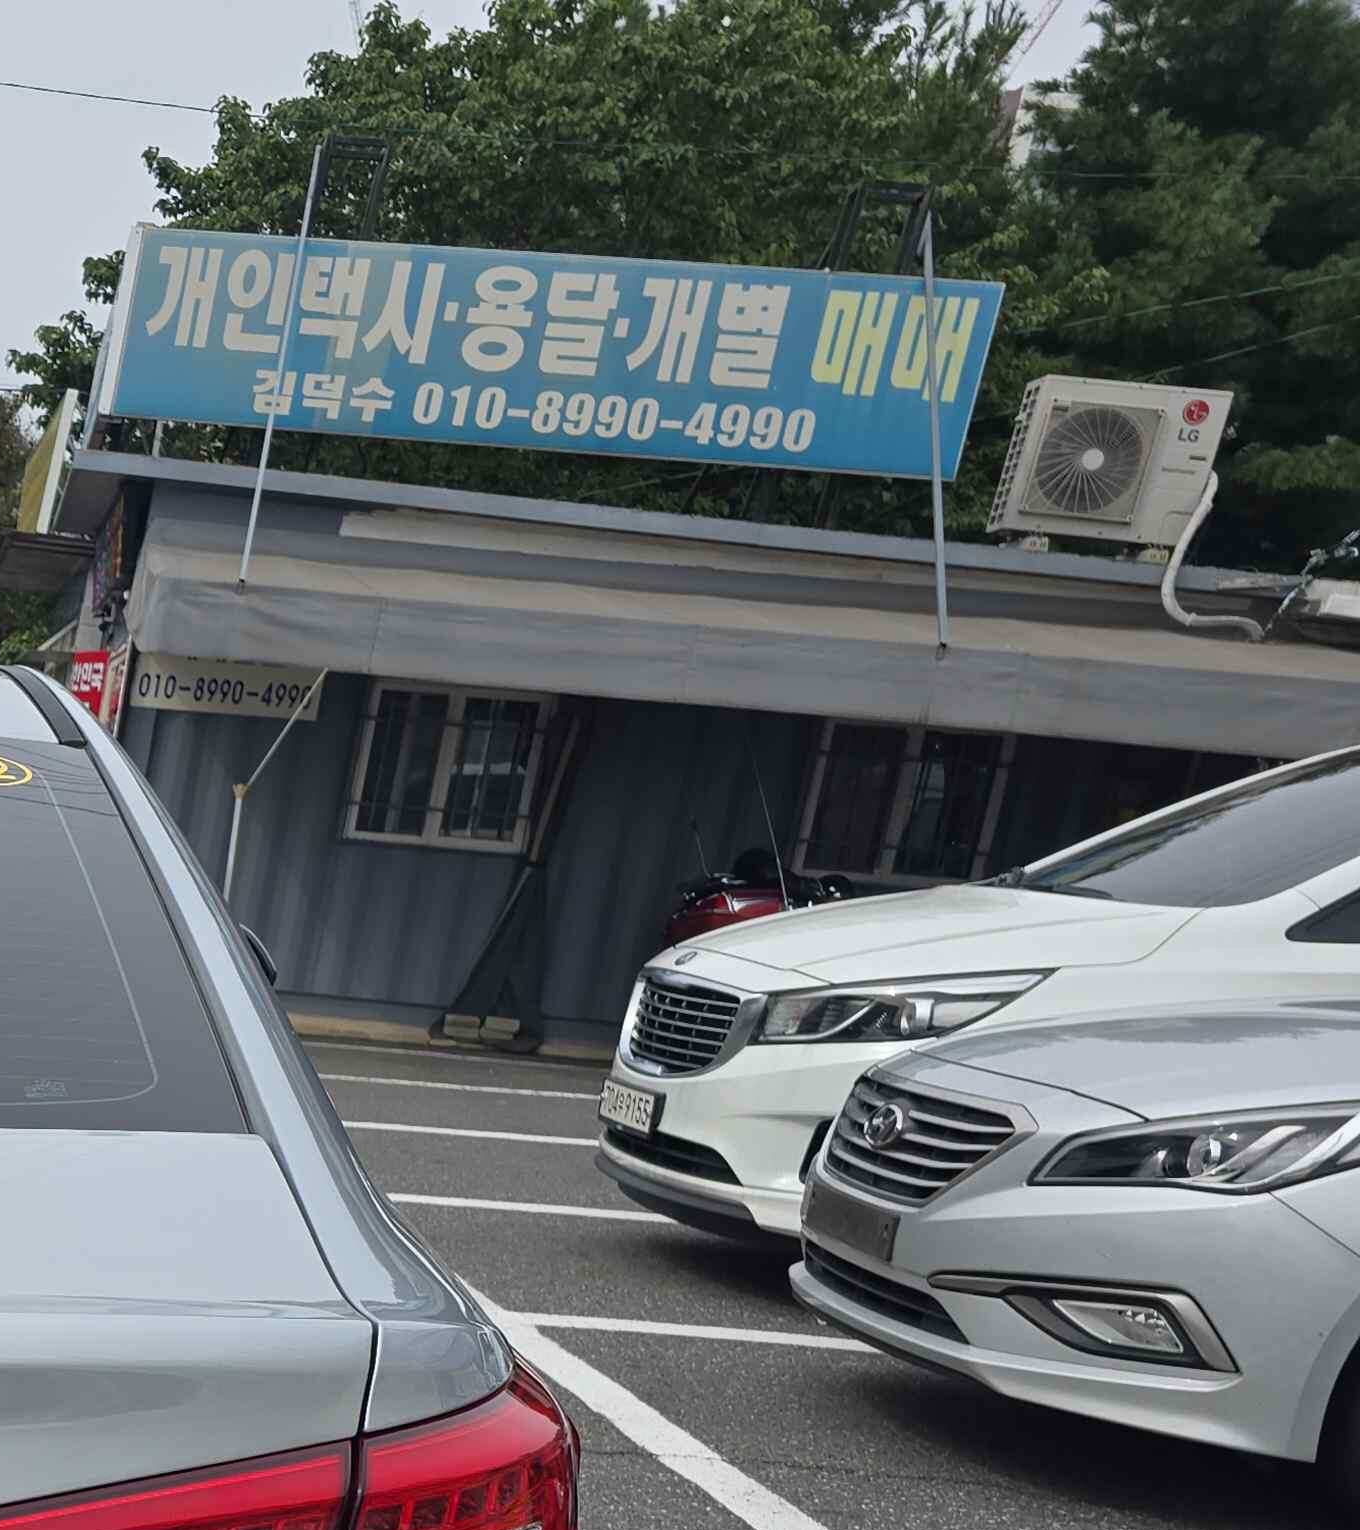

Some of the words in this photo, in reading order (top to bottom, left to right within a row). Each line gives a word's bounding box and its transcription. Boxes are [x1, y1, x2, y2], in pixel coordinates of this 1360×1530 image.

[145, 246, 791, 390] 개인택시·용달·개별
[810, 289, 981, 402] 매매
[253, 369, 395, 422] 김덕수
[412, 382, 816, 453] 010-8990-4990
[1177, 427, 1200, 442] LG
[139, 673, 313, 709] 010-8990-4990
